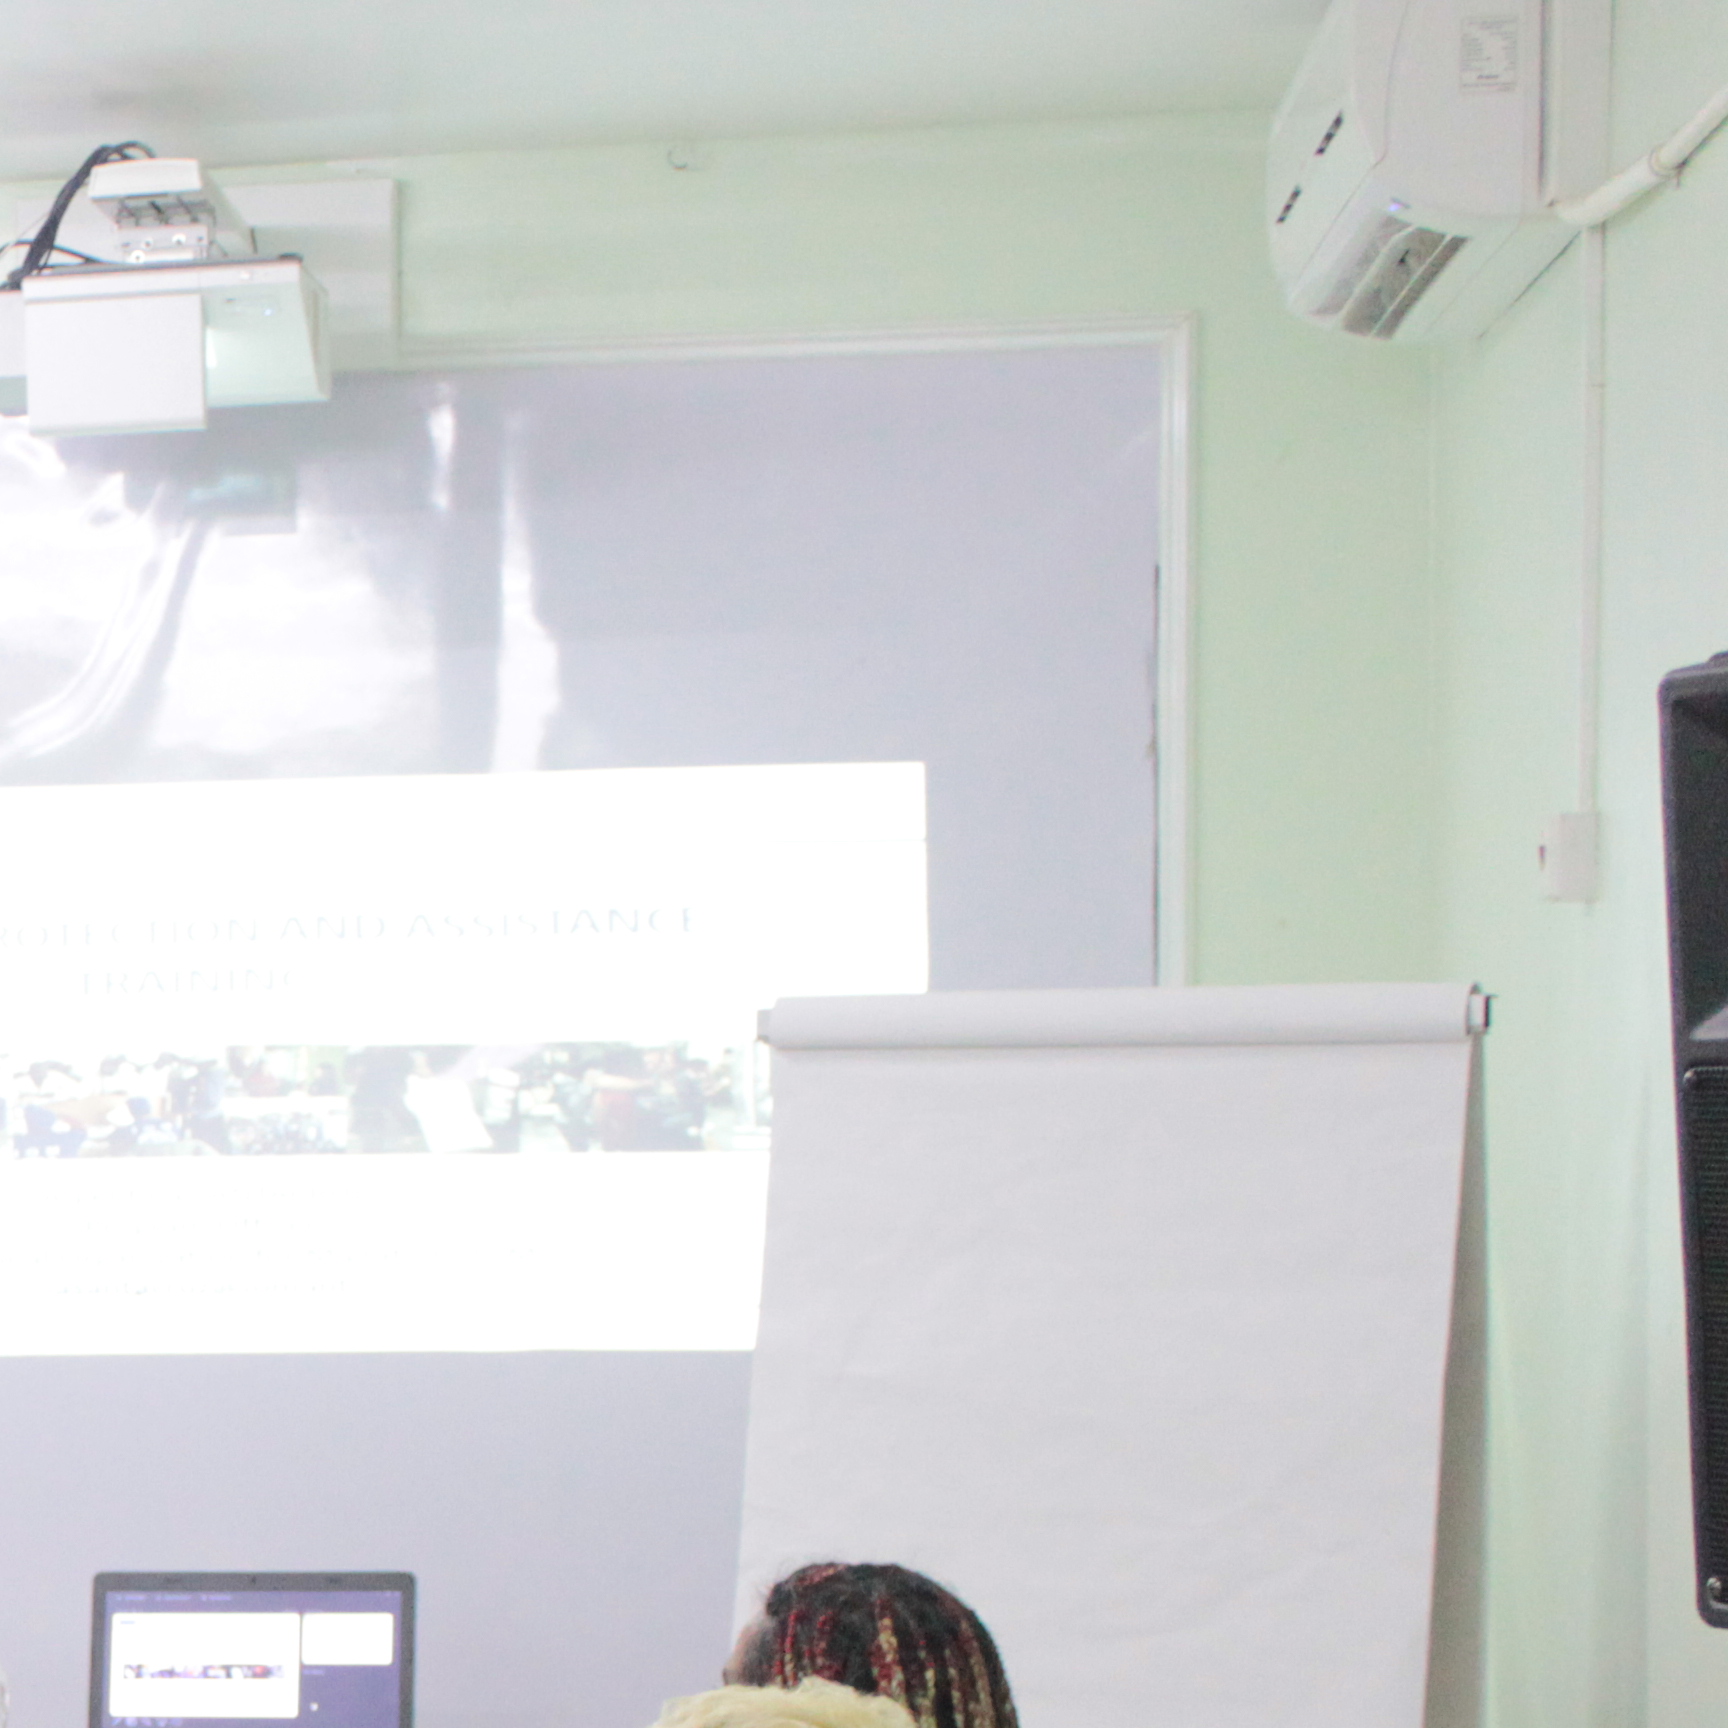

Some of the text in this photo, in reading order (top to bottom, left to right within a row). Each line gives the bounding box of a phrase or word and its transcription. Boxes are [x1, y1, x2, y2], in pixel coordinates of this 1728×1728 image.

[278, 913, 387, 942] AND
[406, 906, 698, 938] ASSISTANCE
[81, 967, 304, 995] TRAINING
